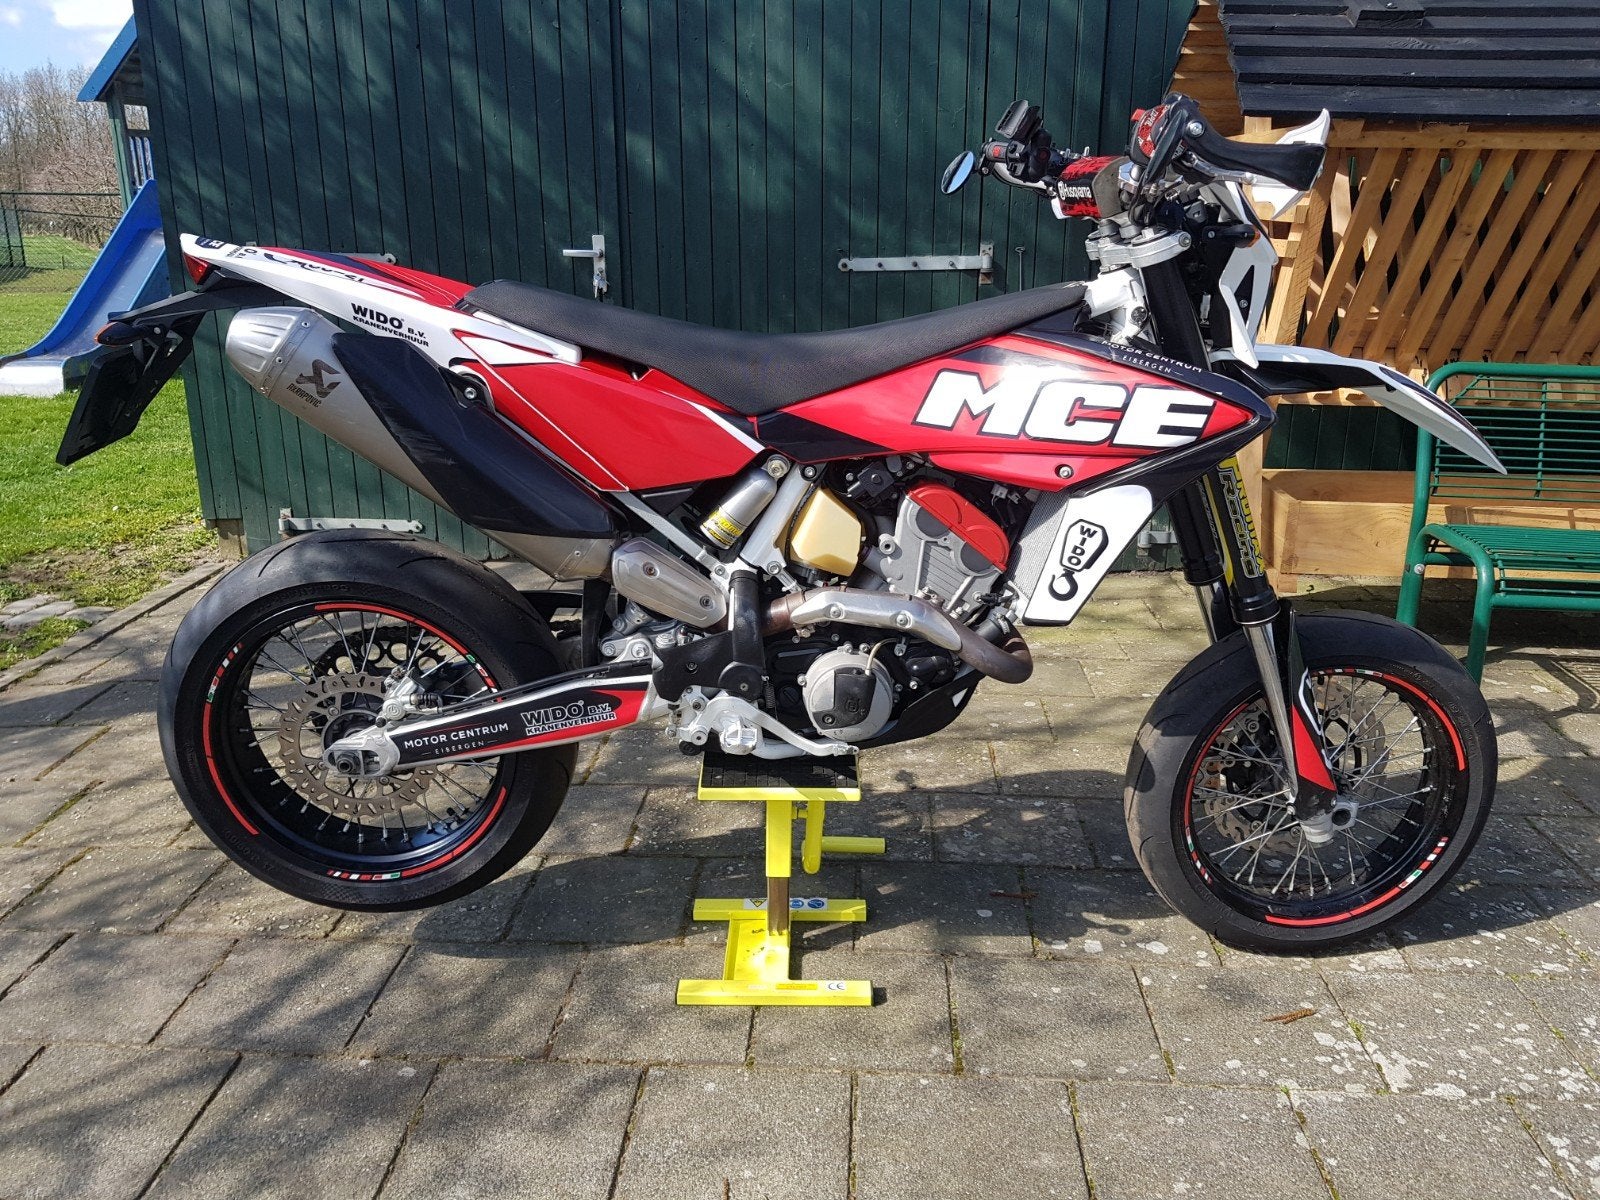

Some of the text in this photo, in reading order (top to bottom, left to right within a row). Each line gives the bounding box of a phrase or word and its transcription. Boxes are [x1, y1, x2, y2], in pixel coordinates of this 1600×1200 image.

[351, 302, 426, 339] WIDO B.V.
[352, 315, 429, 347] KRANENVERHUUR
[1145, 352, 1202, 373] CENTRUM
[912, 367, 1217, 450] MCE
[1067, 524, 1098, 566] WIDO
[520, 701, 612, 727] WIDO B.V.
[525, 712, 617, 736] KRANENVERHUUR
[404, 722, 509, 749] MOTOR CENTRUM
